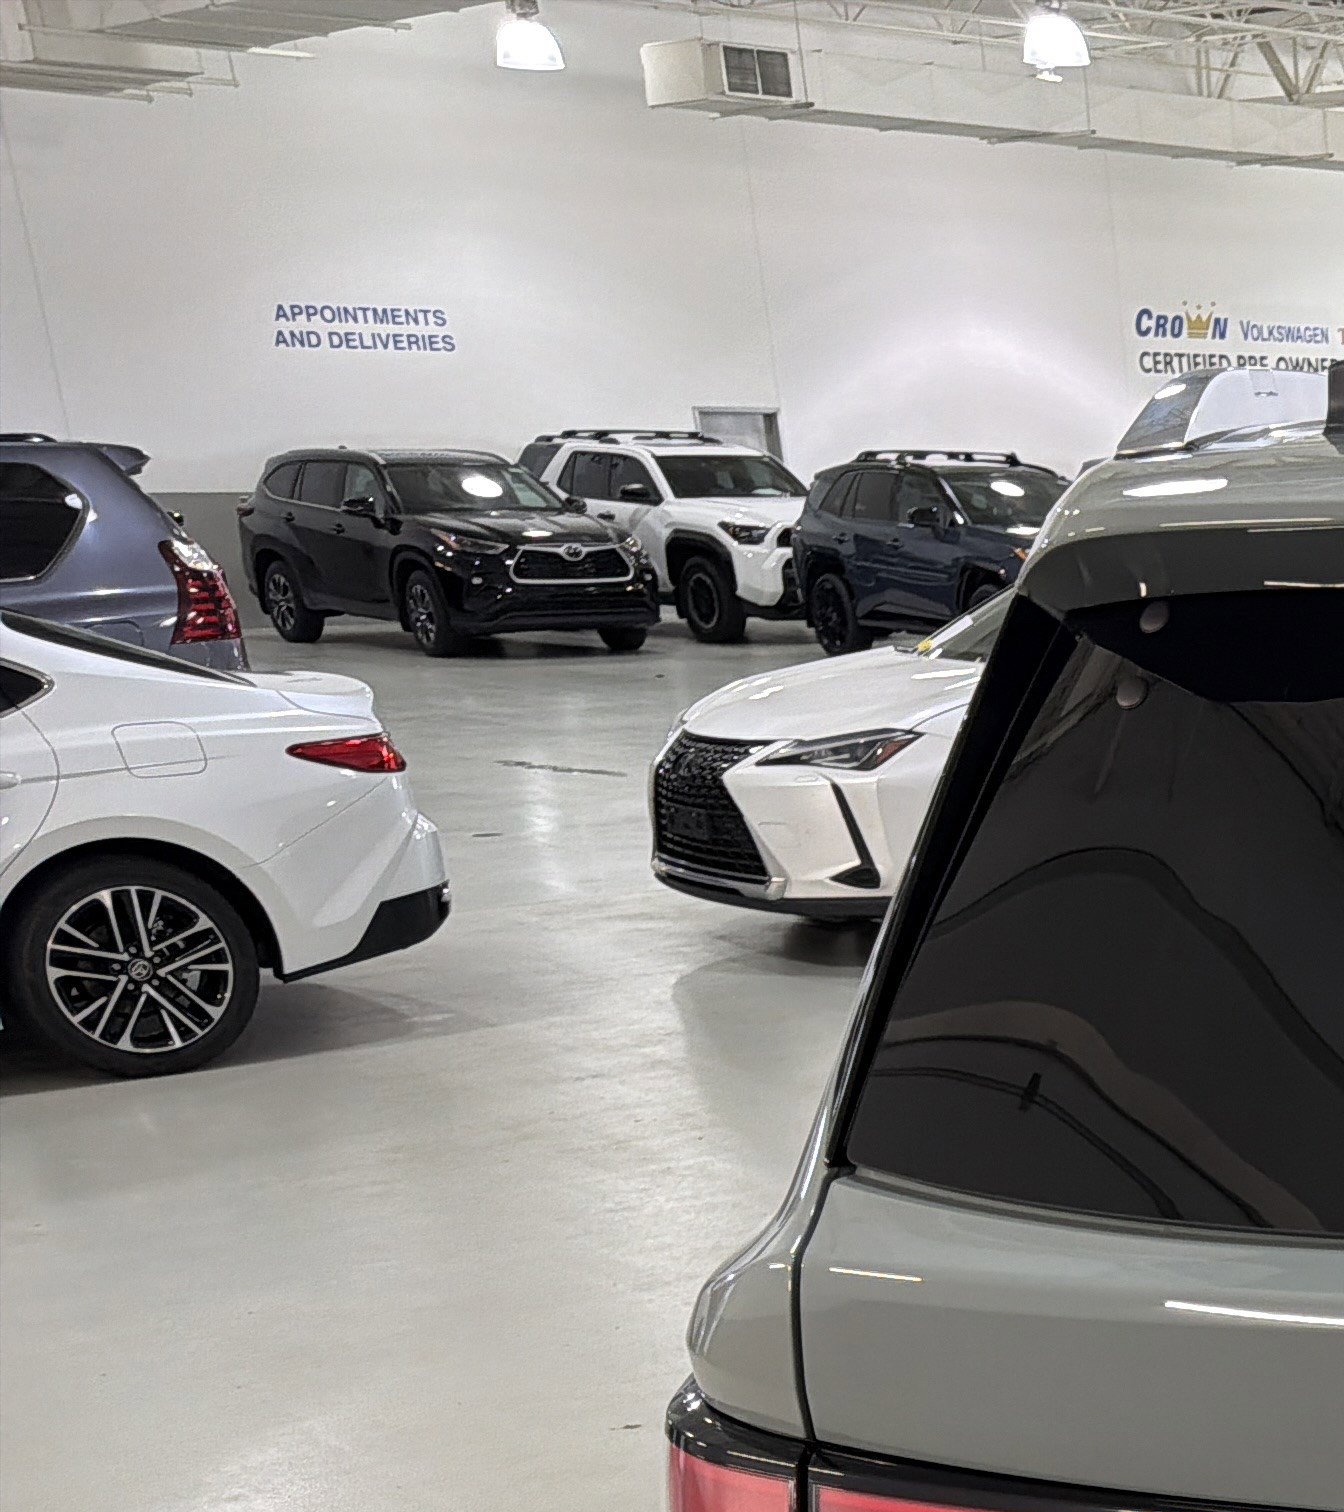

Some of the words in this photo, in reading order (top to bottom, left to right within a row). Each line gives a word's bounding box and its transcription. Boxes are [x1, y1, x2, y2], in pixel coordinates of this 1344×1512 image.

[274, 303, 448, 327] APPOINTMENTS
[1135, 300, 1229, 340] CROWN
[1240, 319, 1330, 344] VOLKSWAGEN
[274, 329, 322, 349] AND
[327, 331, 457, 353] DELIVERIES
[1275, 356, 1337, 374] OWNE
